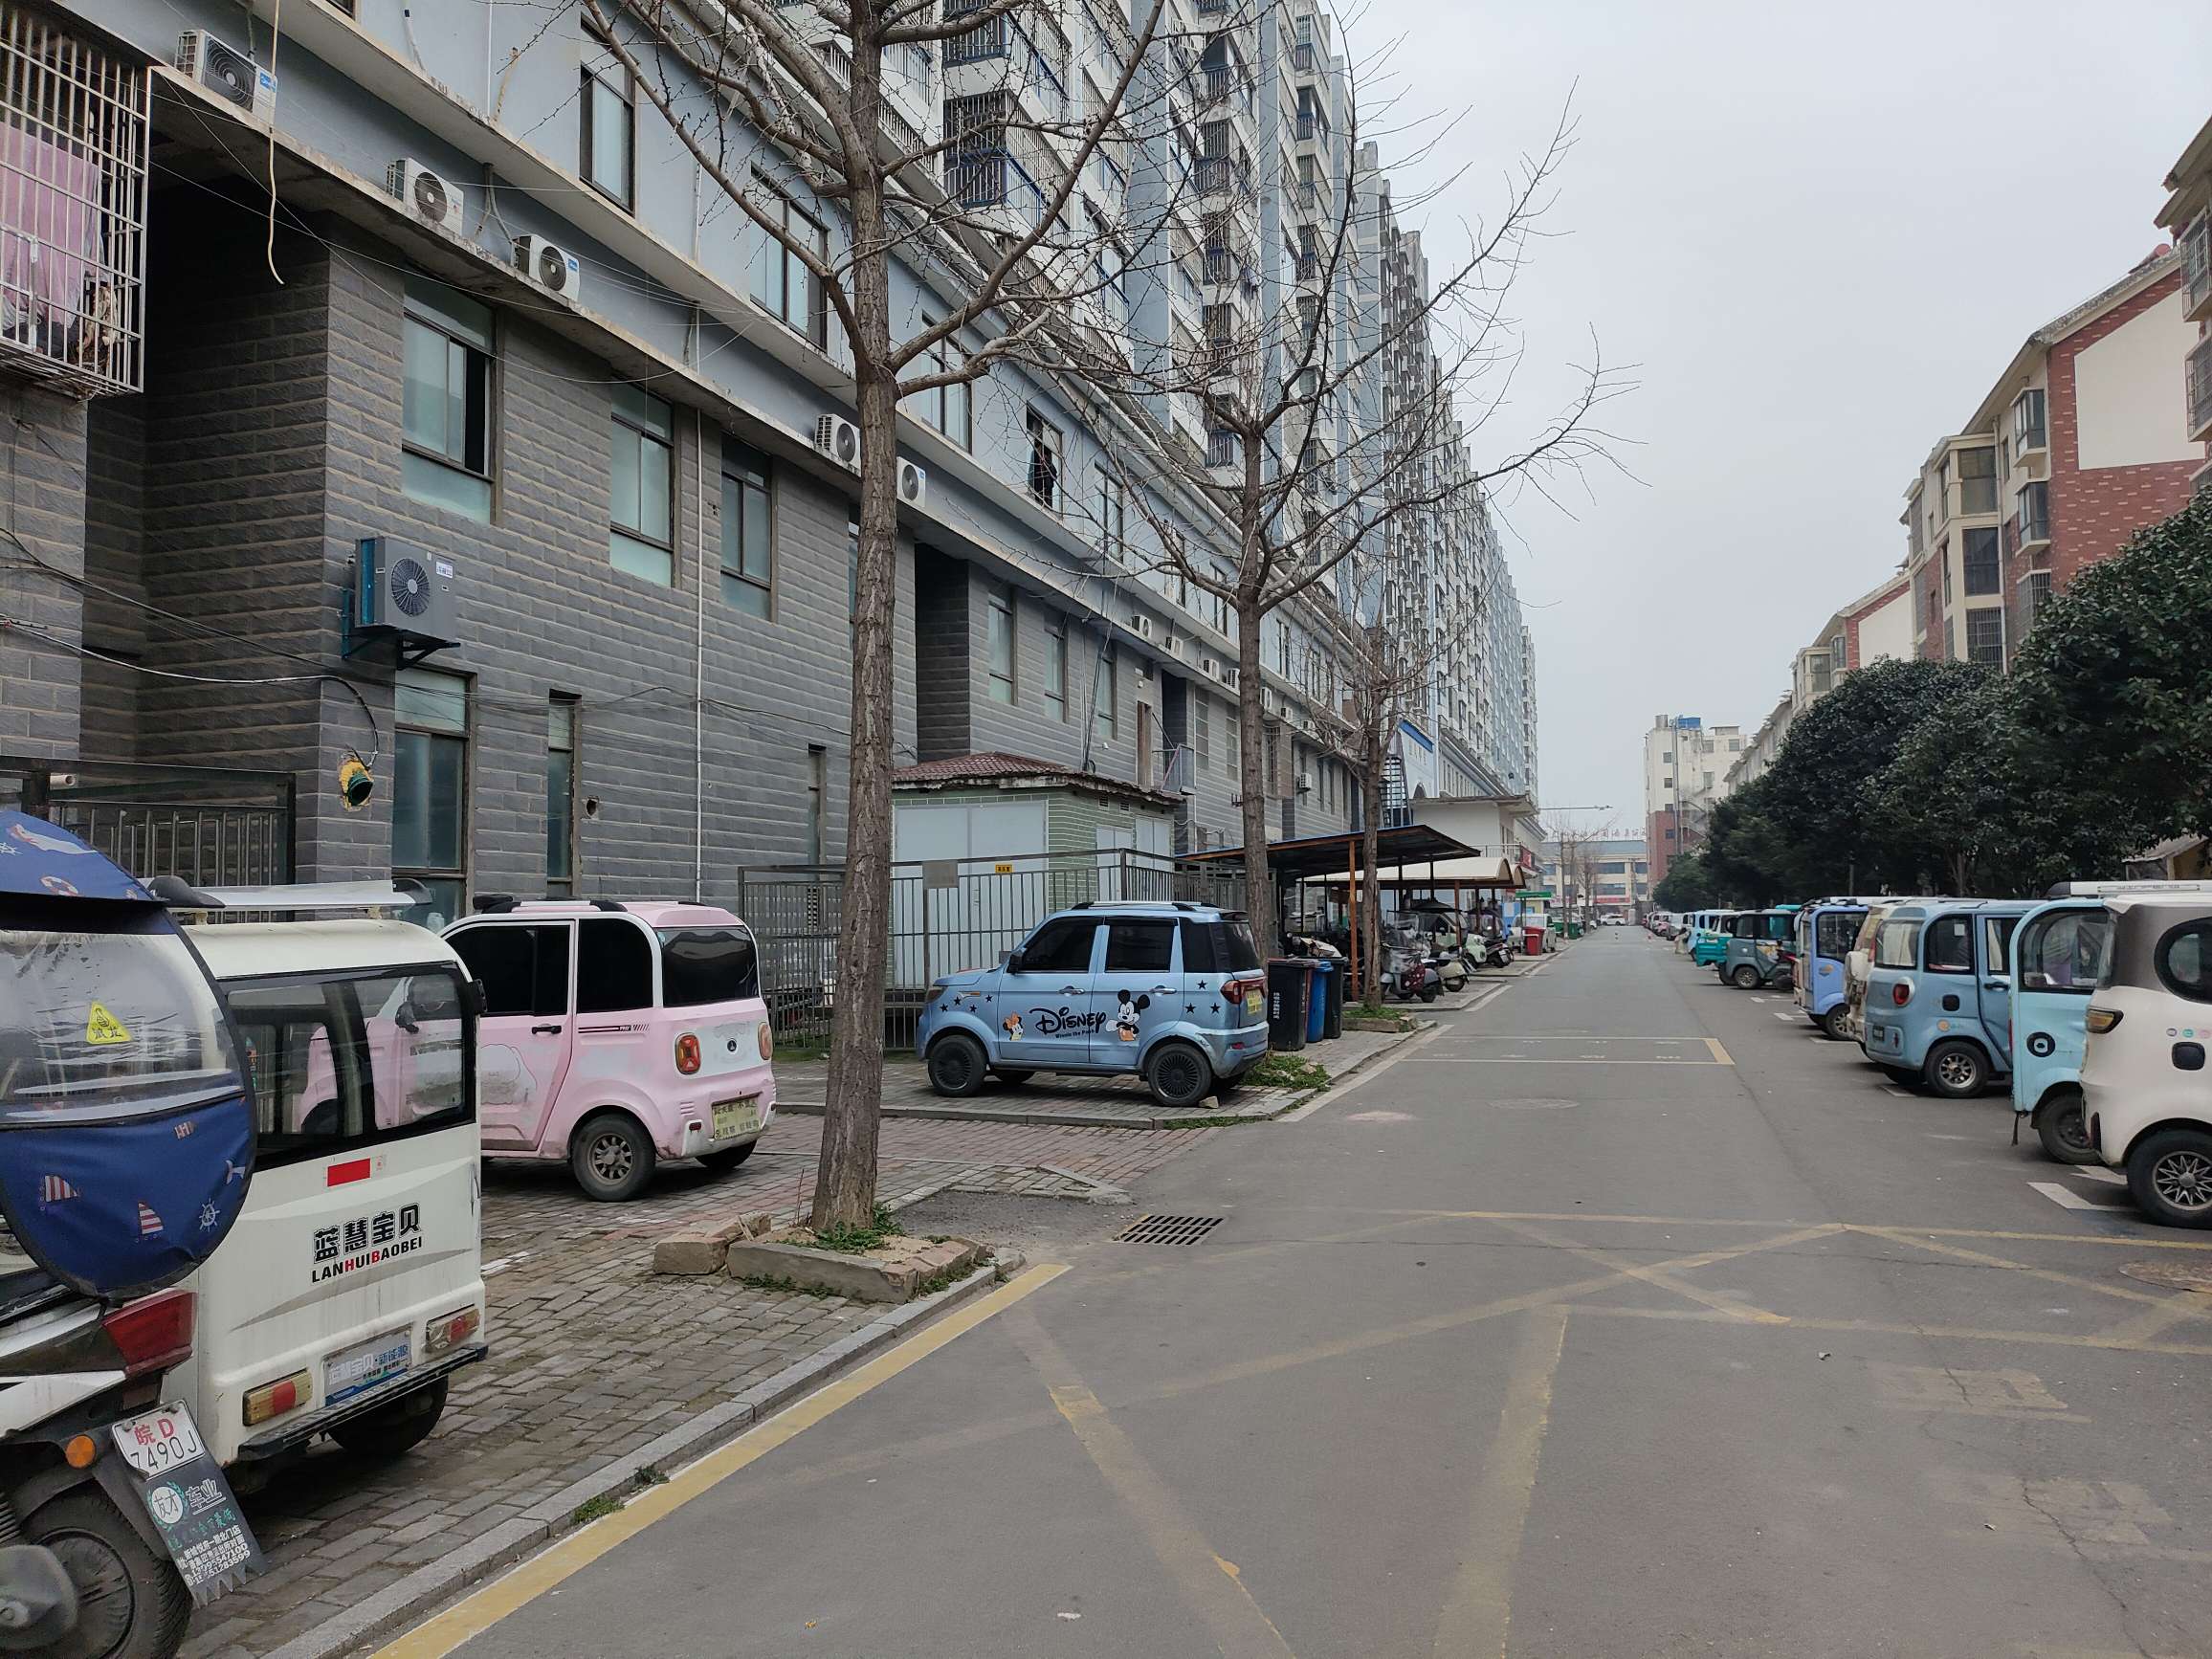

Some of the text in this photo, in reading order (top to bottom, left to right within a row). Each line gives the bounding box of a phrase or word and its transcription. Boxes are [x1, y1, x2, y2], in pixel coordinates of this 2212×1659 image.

[314, 1203, 421, 1264] 蓝慧宝贝
[312, 1236, 422, 1283] LANHUIBAOBEI
[185, 1478, 223, 1509] 车业
